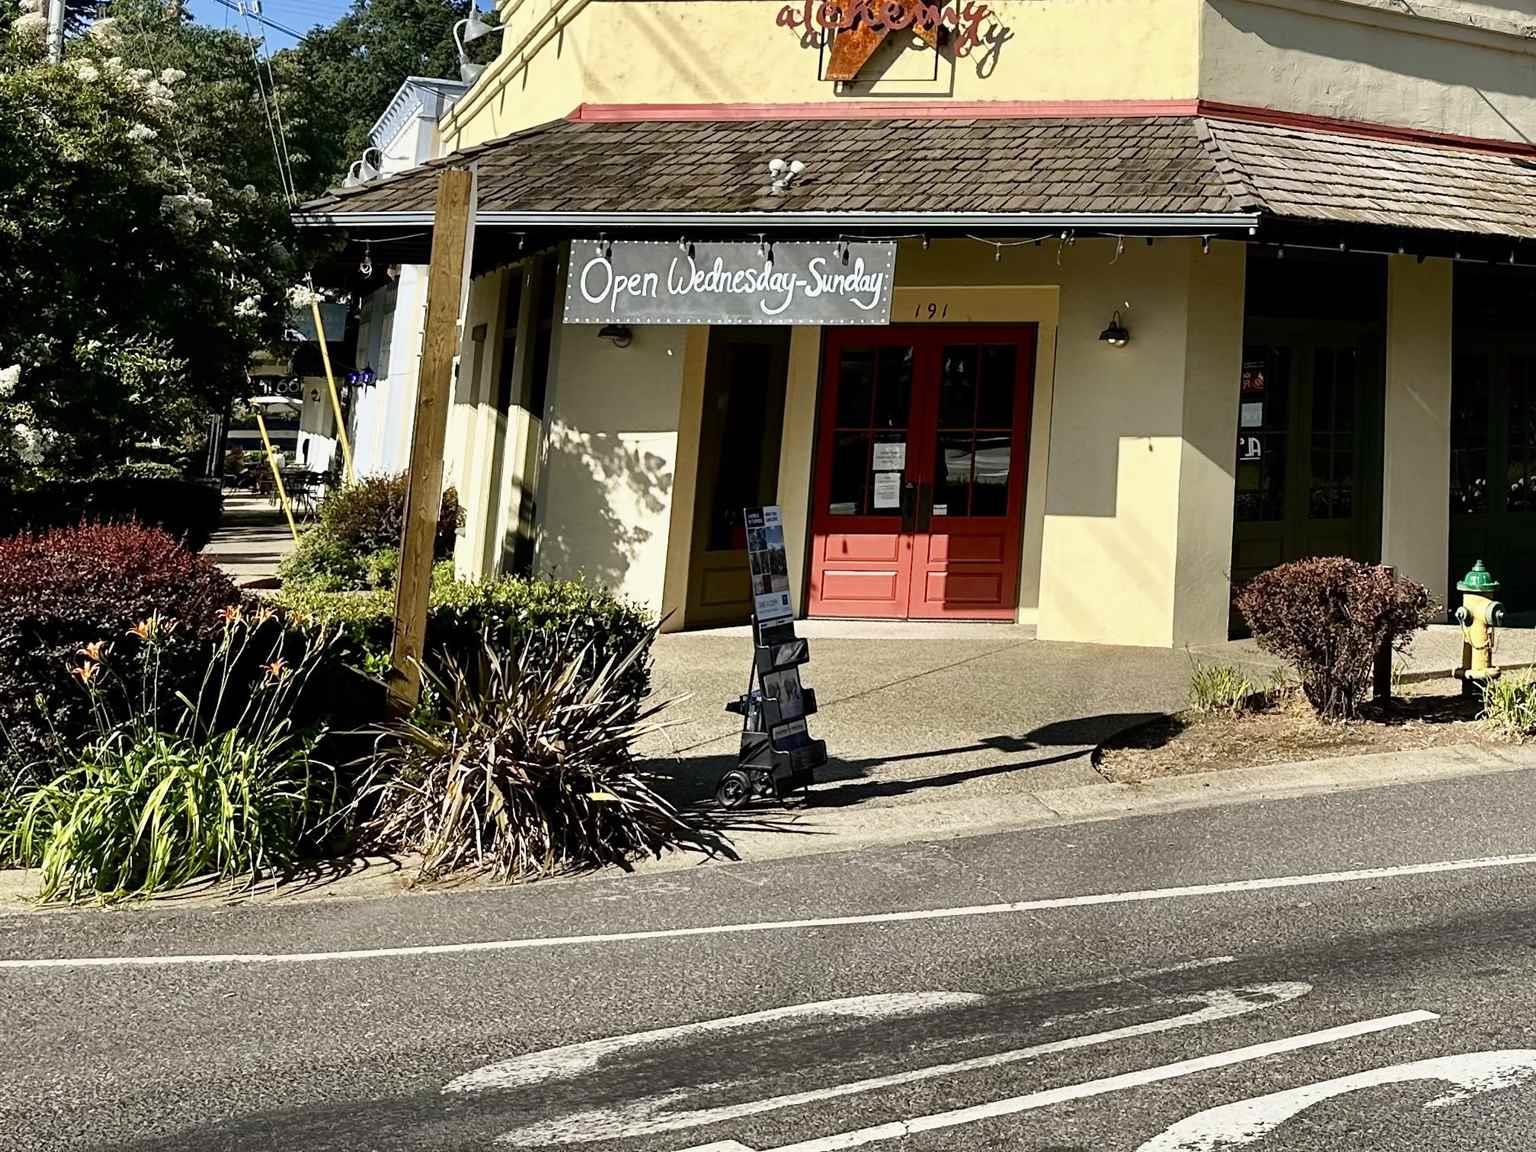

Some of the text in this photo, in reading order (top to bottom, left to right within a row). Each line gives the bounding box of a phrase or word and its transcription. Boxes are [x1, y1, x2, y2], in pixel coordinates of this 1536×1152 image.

[580, 256, 885, 315] Open Wednesday-Sunday
[915, 303, 949, 319] 191
